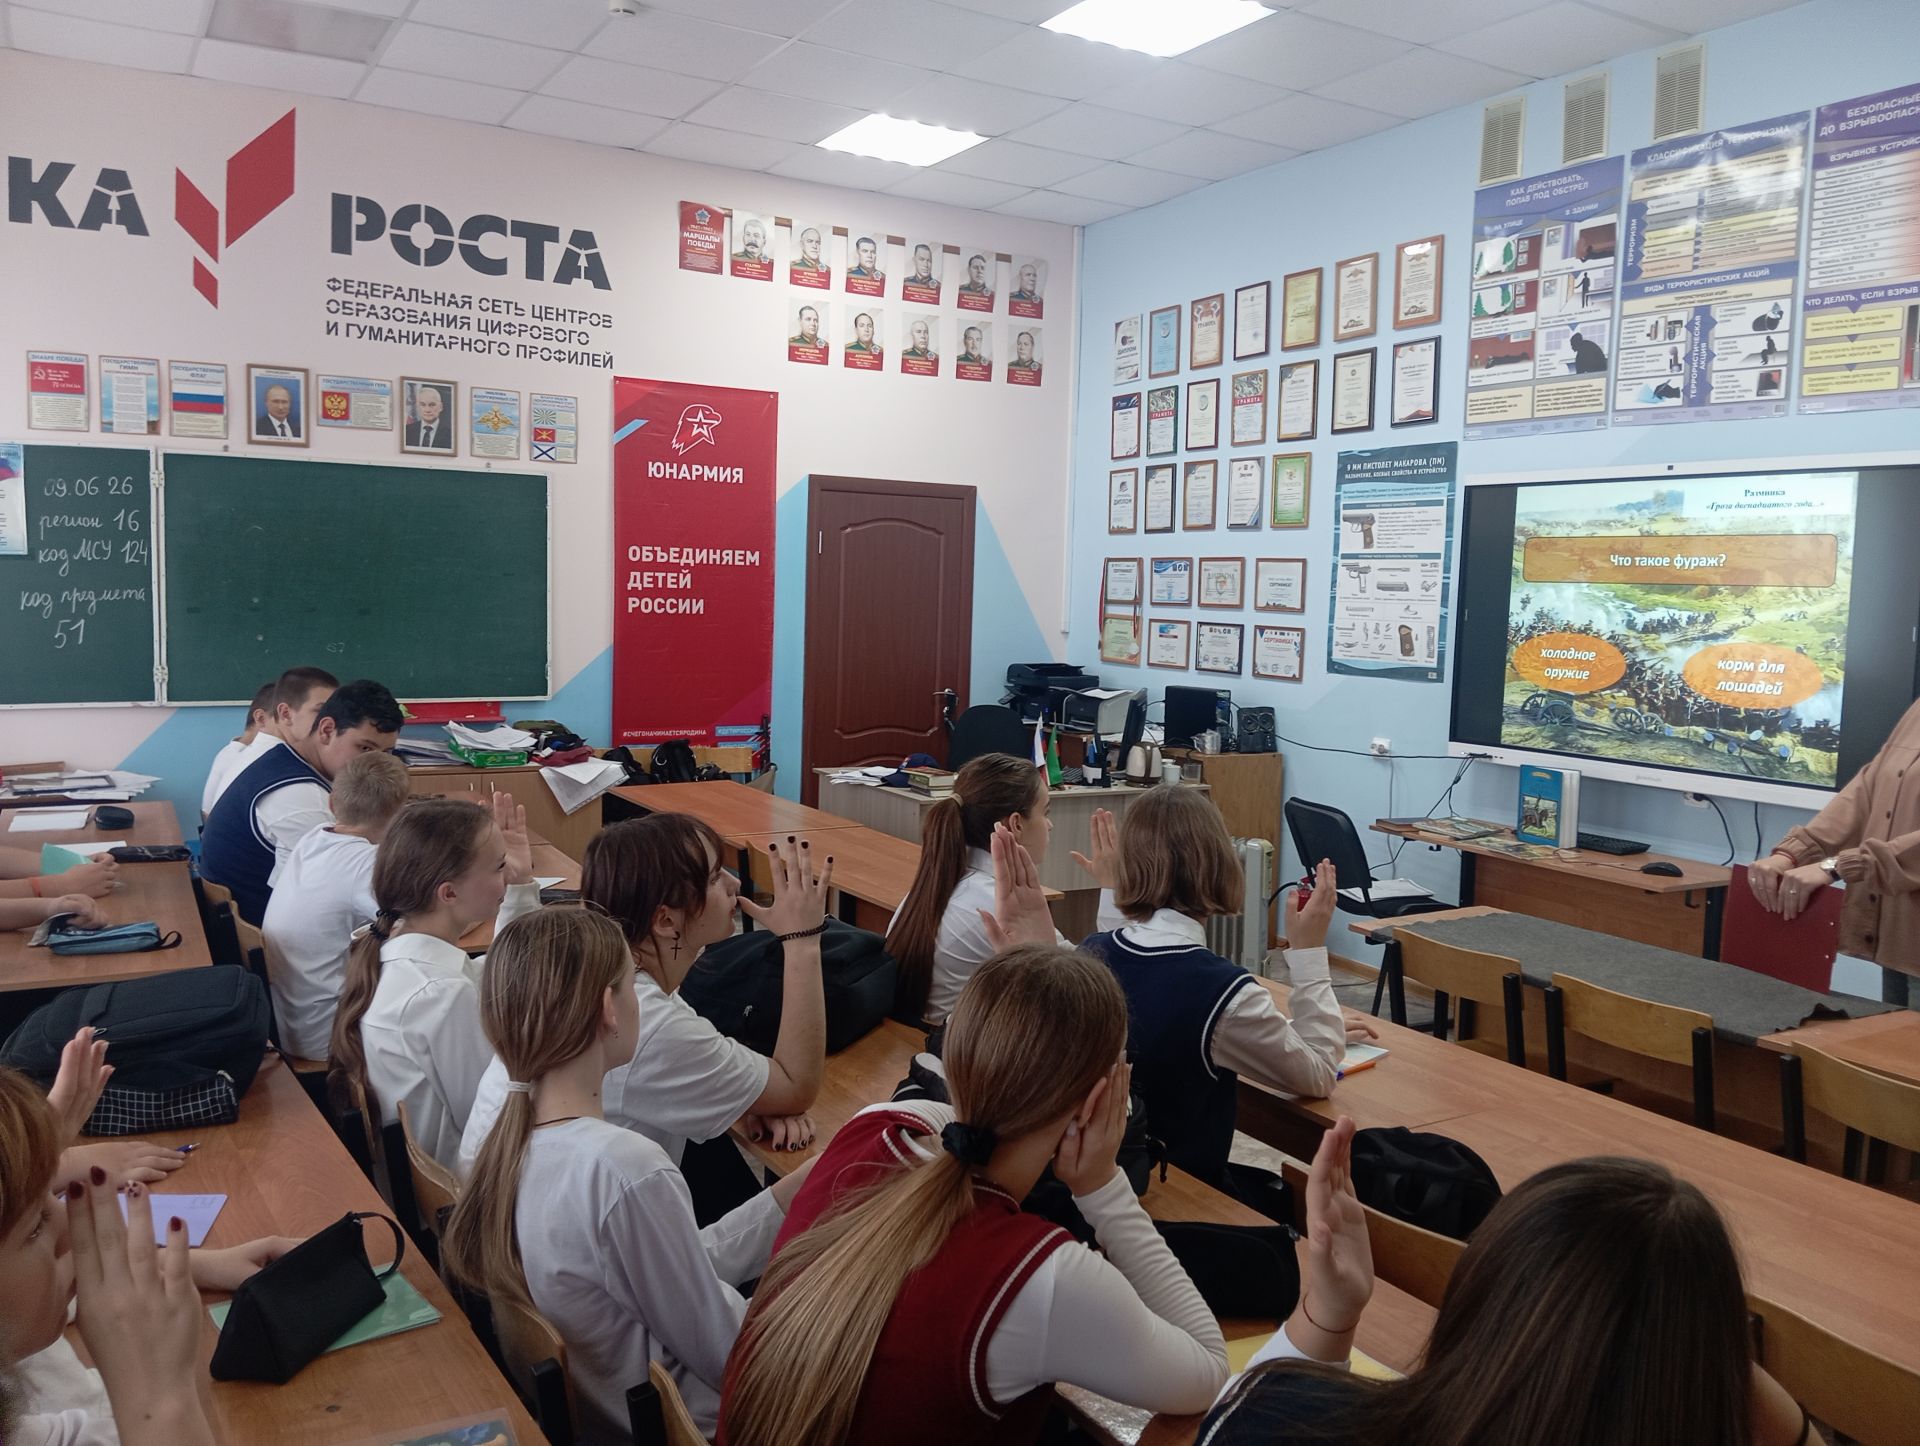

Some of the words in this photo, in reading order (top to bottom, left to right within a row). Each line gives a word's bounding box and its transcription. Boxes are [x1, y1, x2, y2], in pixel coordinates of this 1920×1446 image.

[1820, 125, 1836, 136] ДО
[1830, 146, 1878, 162] ВЗРЫВНОЕ
[1506, 195, 1531, 207] ПОПАВ
[1533, 190, 1550, 200] ПОД
[1552, 182, 1589, 196] ОБСТРЕЛ
[1510, 187, 1525, 196] КАК
[1527, 174, 1584, 192] ДЕЙСТВОВАТЬ,
[8, 156, 150, 237] КА
[331, 192, 612, 291] РОСТА
[684, 231, 720, 243] МАРШАЛЫ
[687, 240, 716, 249] ПОБЕДЫ
[1627, 219, 1638, 266] ТЕРРОРИЗМ
[1644, 284, 1664, 294] ВИДЫ
[1666, 273, 1740, 289] ТЕРРОРИСТИЧЕСКИХ
[1743, 268, 1769, 279] АКЦИЙ
[326, 277, 472, 310] ФЕДЕРАЛЬНАЯ
[478, 297, 526, 317] СЕТЬ
[532, 305, 613, 329] ЦЕНТРОВ
[1806, 298, 1821, 306] ЧТО
[1823, 294, 1858, 305] ДЕЛАТЬ,
[1861, 290, 1885, 300] ЕСЛИ
[1888, 286, 1918, 296] ВЗРЫВ
[326, 299, 471, 331] ОБРАЗОВАНИЯ
[478, 318, 590, 346] ЦИФРОВОГО
[326, 321, 339, 336] И
[346, 323, 510, 356] ГУМАНИТАРНОГО
[516, 343, 613, 369] ПРОФИЛЕЙ
[1690, 315, 1701, 399] ТЕРРОРИСТИЧЕСКАЯ
[1237, 397, 1261, 405] ГРАМОТА
[1152, 411, 1174, 419] ГРАМОТА
[648, 461, 744, 483] ЮНАРМИЯ
[1363, 461, 1392, 470] ПИСТОЛЕТ
[1393, 458, 1427, 468] МАКАРОВА
[1429, 457, 1445, 467] (ПМ)
[108, 476, 133, 495] 26
[1744, 489, 1786, 497] Разминка
[39, 513, 103, 541] регион
[113, 508, 140, 532] 16
[38, 547, 69, 577] код
[74, 538, 112, 561] МСУ
[121, 540, 148, 566] 124
[628, 545, 760, 566] ОБЪЕДИНЯЕМ
[1610, 554, 1632, 566] Что
[1634, 555, 1670, 567] такое
[1673, 553, 1727, 569] фураж?
[627, 569, 692, 591] ДЕТЕЙ
[21, 590, 53, 619] код
[60, 587, 146, 616] предмета
[628, 597, 705, 615] РОССИИ
[54, 618, 85, 649] 51
[1540, 647, 1597, 661] холодное
[1544, 667, 1590, 681] оружие
[1717, 659, 1755, 675] корм
[1758, 659, 1785, 674] для
[1716, 680, 1784, 695] лошадей
[623, 729, 707, 738] #СЧЕГОНАЧИНАЕТСЯРОДИНА
